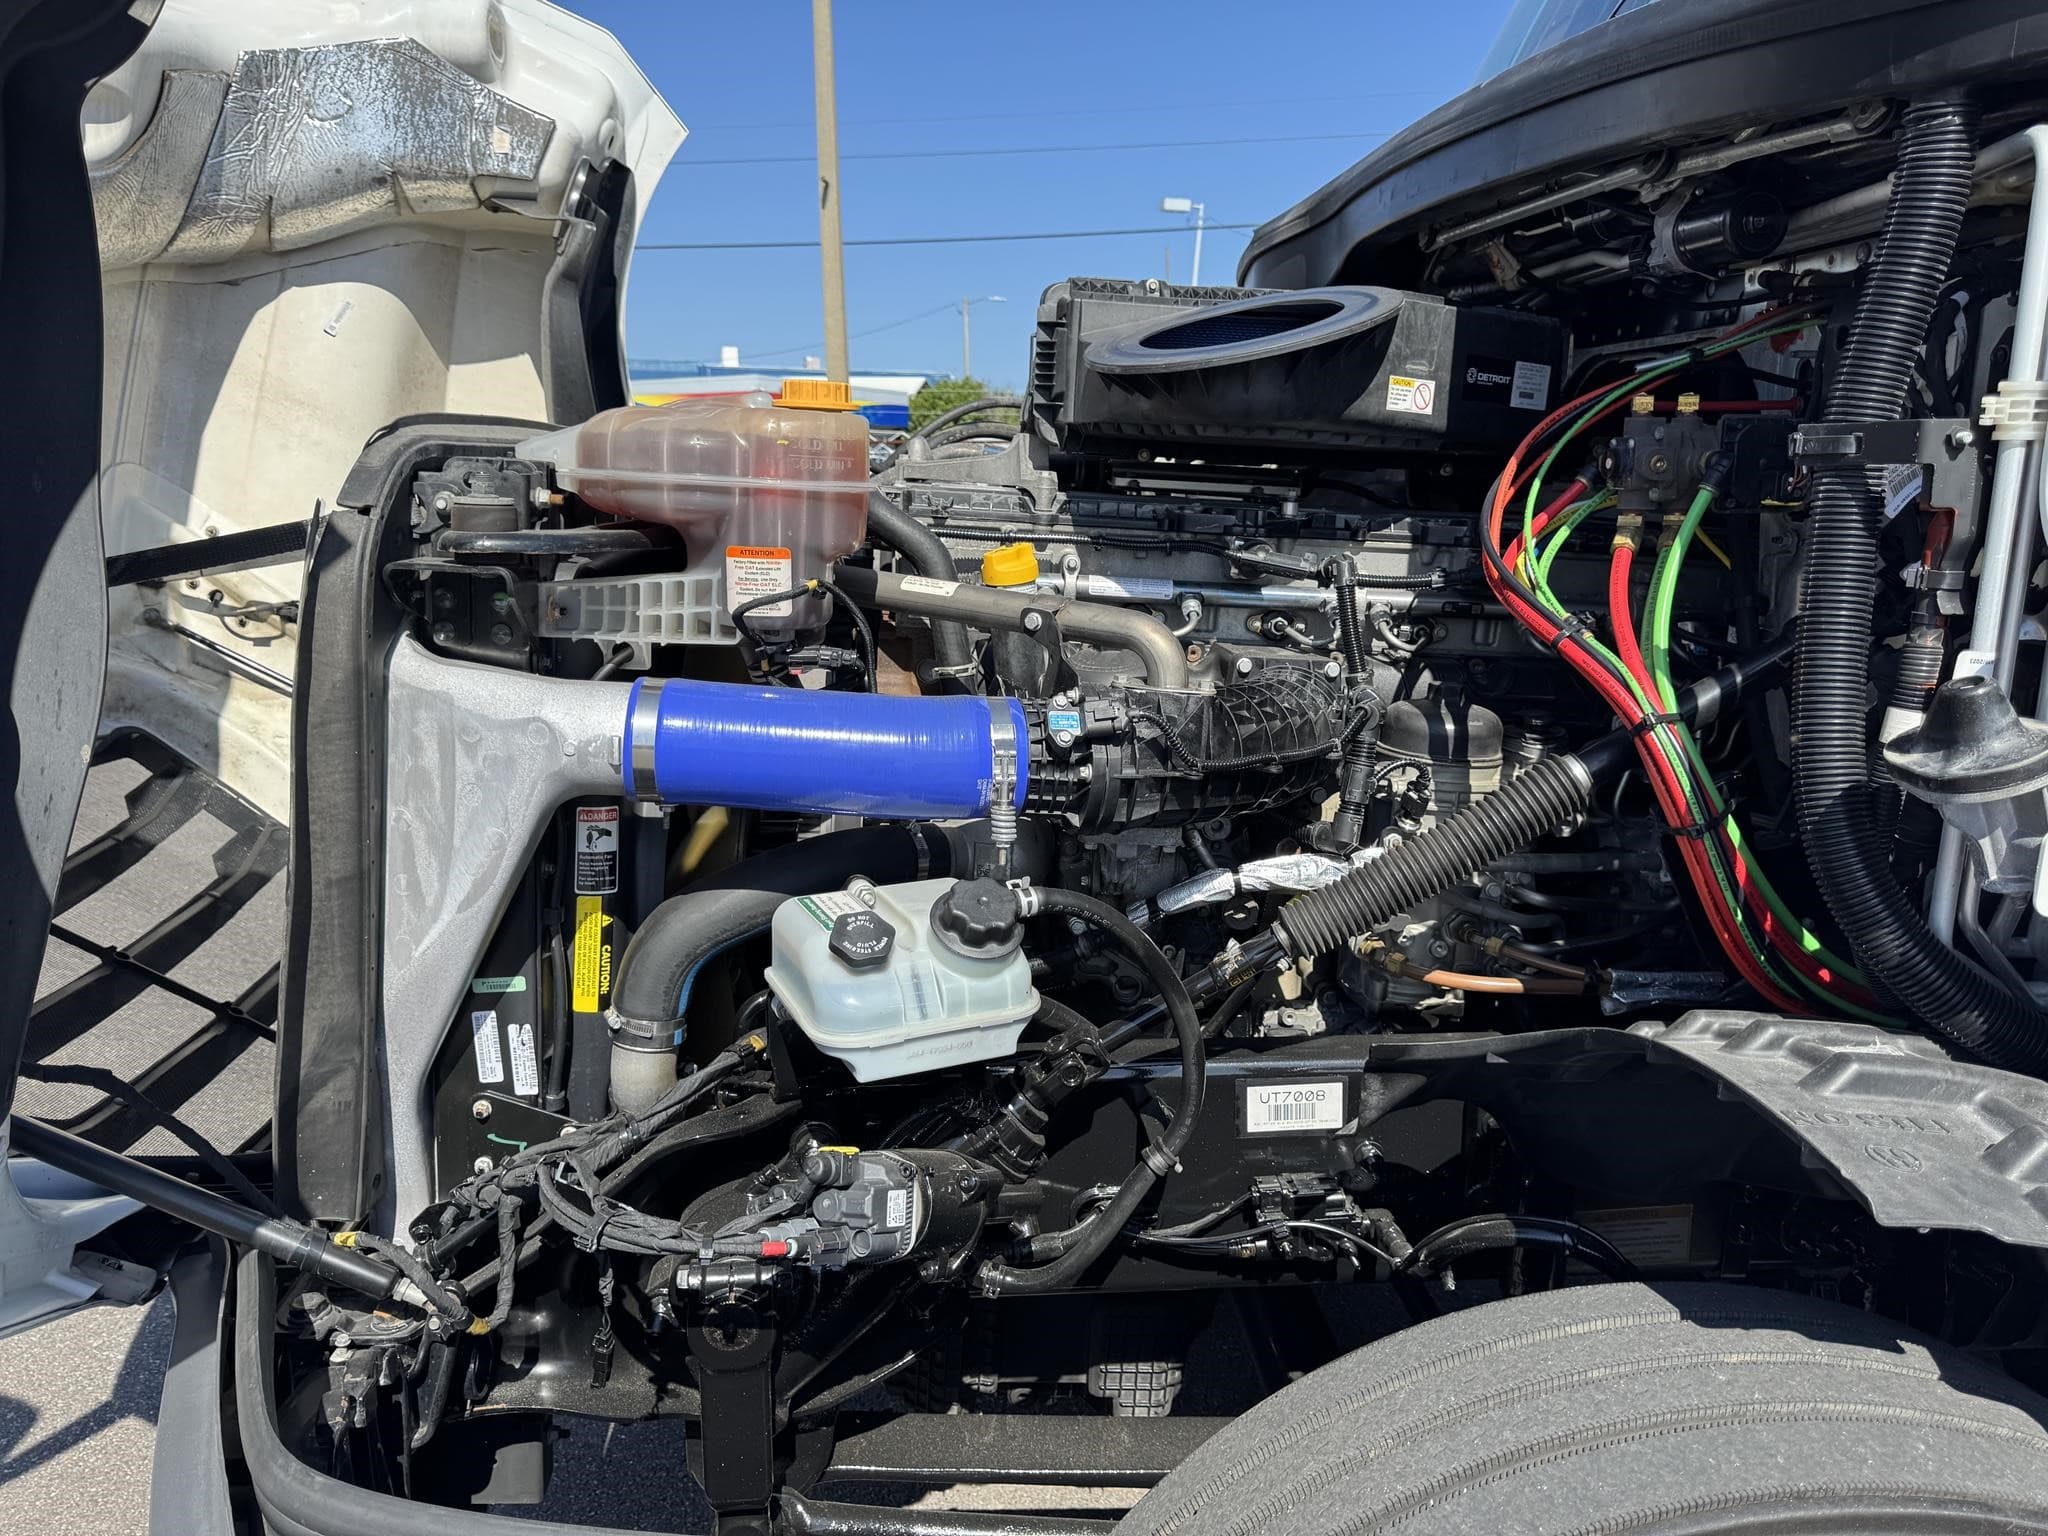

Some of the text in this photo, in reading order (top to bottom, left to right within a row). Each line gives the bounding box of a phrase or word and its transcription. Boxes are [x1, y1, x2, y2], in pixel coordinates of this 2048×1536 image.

[1477, 372, 1511, 384] DETROIT
[791, 458, 823, 471] COLD
[740, 549, 775, 557] ATTENTION
[588, 811, 617, 821] DANGER
[846, 920, 874, 931] OVERFILL
[857, 940, 877, 948] FLUID
[600, 945, 612, 995] CAUTION:
[1259, 1089, 1327, 1104] UT7008
